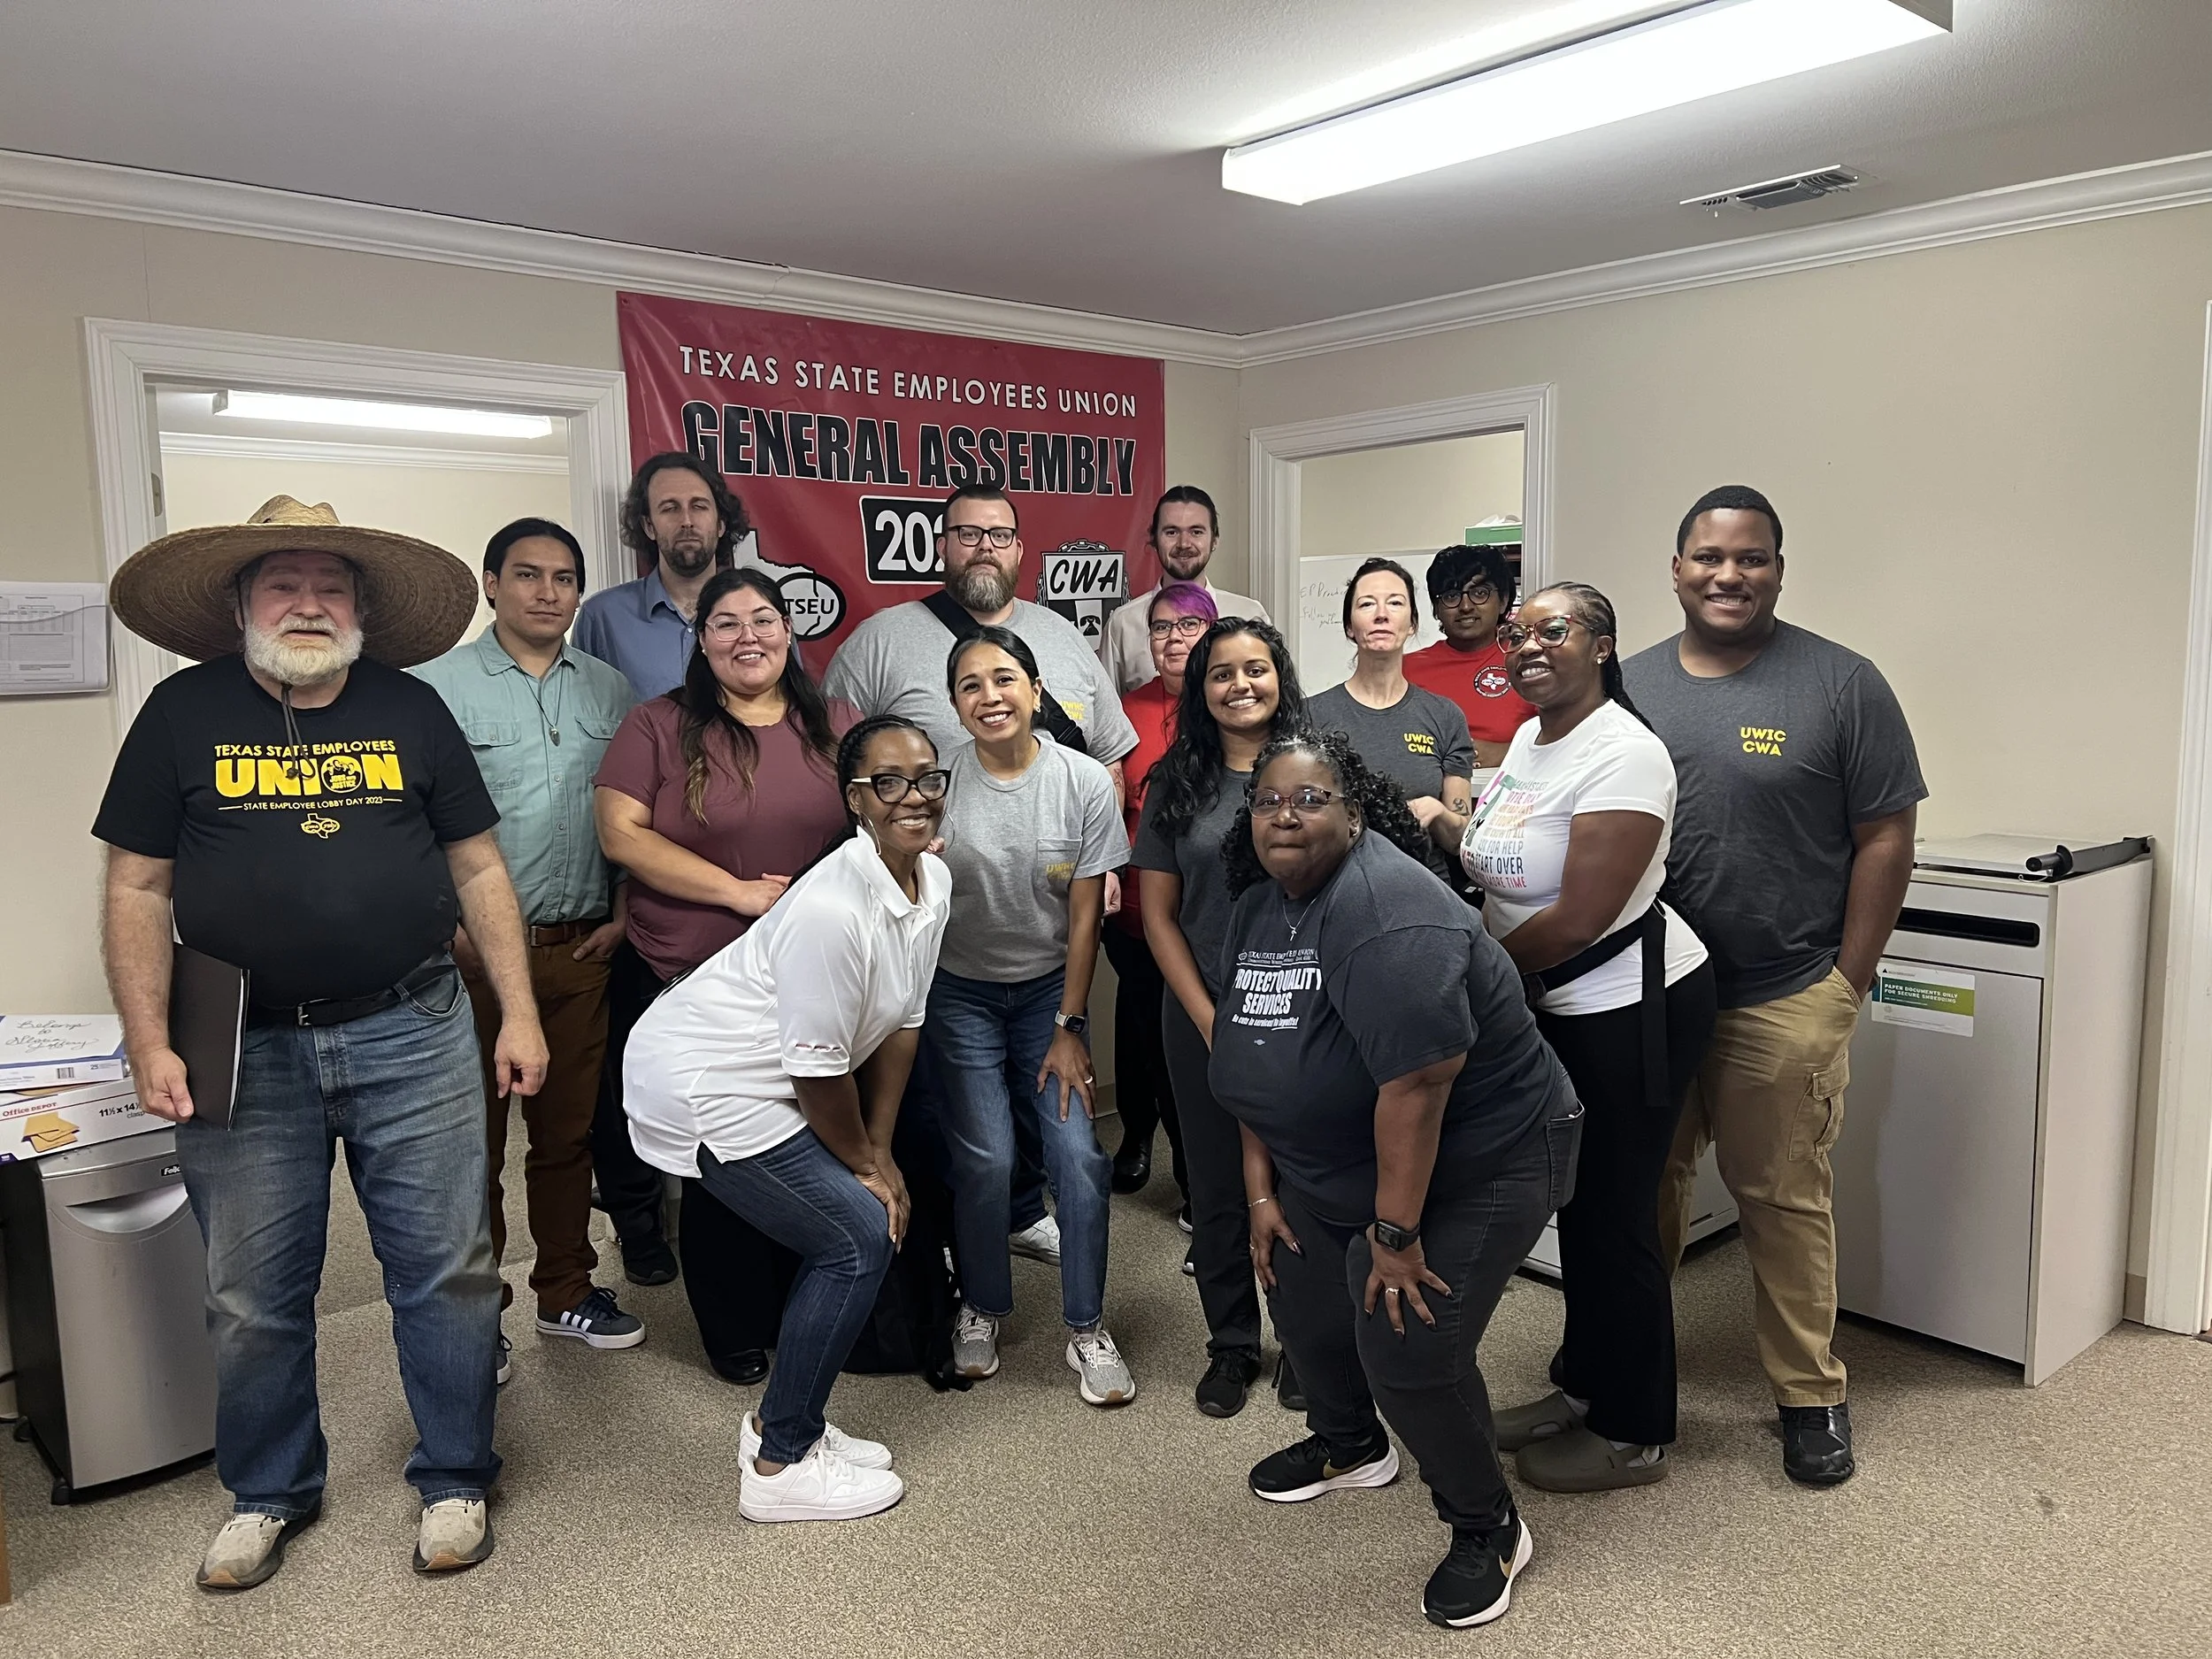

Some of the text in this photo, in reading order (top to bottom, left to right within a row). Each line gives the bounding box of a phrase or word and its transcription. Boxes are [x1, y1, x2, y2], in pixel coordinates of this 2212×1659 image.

[679, 345, 1137, 418] TEXAS STATE EMPLOYEES UNION
[681, 401, 1136, 496] GENERAL ASSEMBLY
[1050, 558, 1118, 594] CWA
[784, 598, 834, 615] TSEU
[1403, 733, 1434, 745] UWIC
[1740, 726, 1786, 742] UWIC
[214, 740, 396, 757] TEXAS STATE EMPLOYEES
[1408, 743, 1434, 755] CWA
[1742, 741, 1782, 757] CWA
[215, 754, 403, 798] UNION
[243, 796, 383, 811] STATE EMPLOYEE LOBBY DAY 2023
[1502, 841, 1524, 855] HELP
[1497, 856, 1524, 874] OVER
[1506, 876, 1527, 888] TIME
[1905, 987, 1941, 996] DOCUMENTS
[1922, 995, 1956, 1003] SHREDDING
[1242, 992, 1293, 1015] SERVICES
[3, 1102, 58, 1117] Office DEPOT
